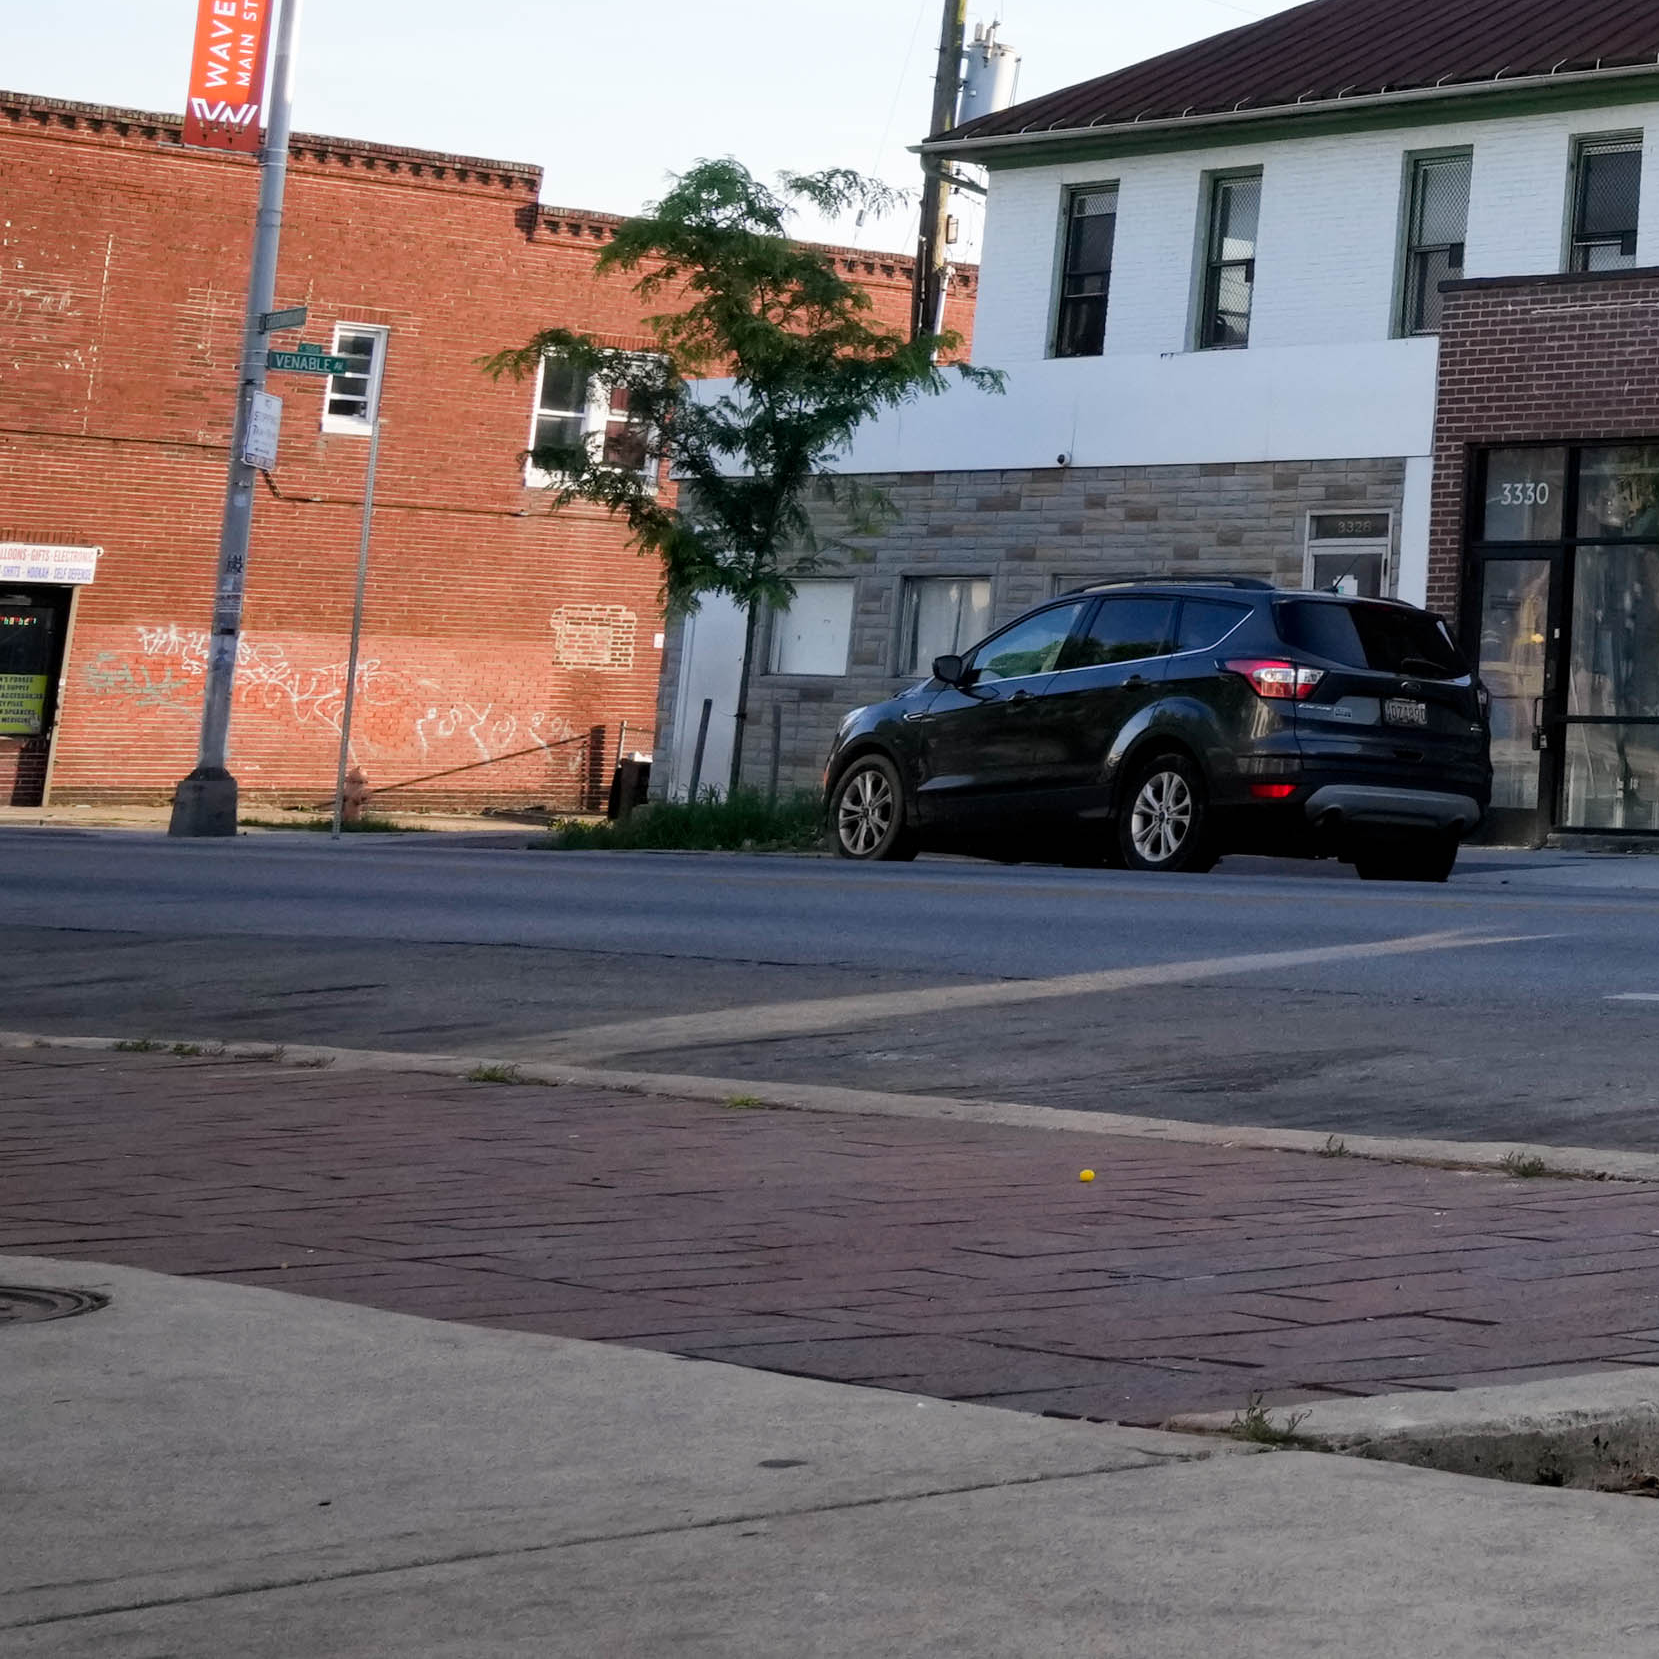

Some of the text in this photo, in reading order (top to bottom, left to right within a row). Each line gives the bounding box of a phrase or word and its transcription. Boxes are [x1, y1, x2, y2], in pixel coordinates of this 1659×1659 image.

[236, 33, 256, 86] MAIN
[276, 354, 332, 372] VENABLE
[1500, 482, 1549, 505] 3330
